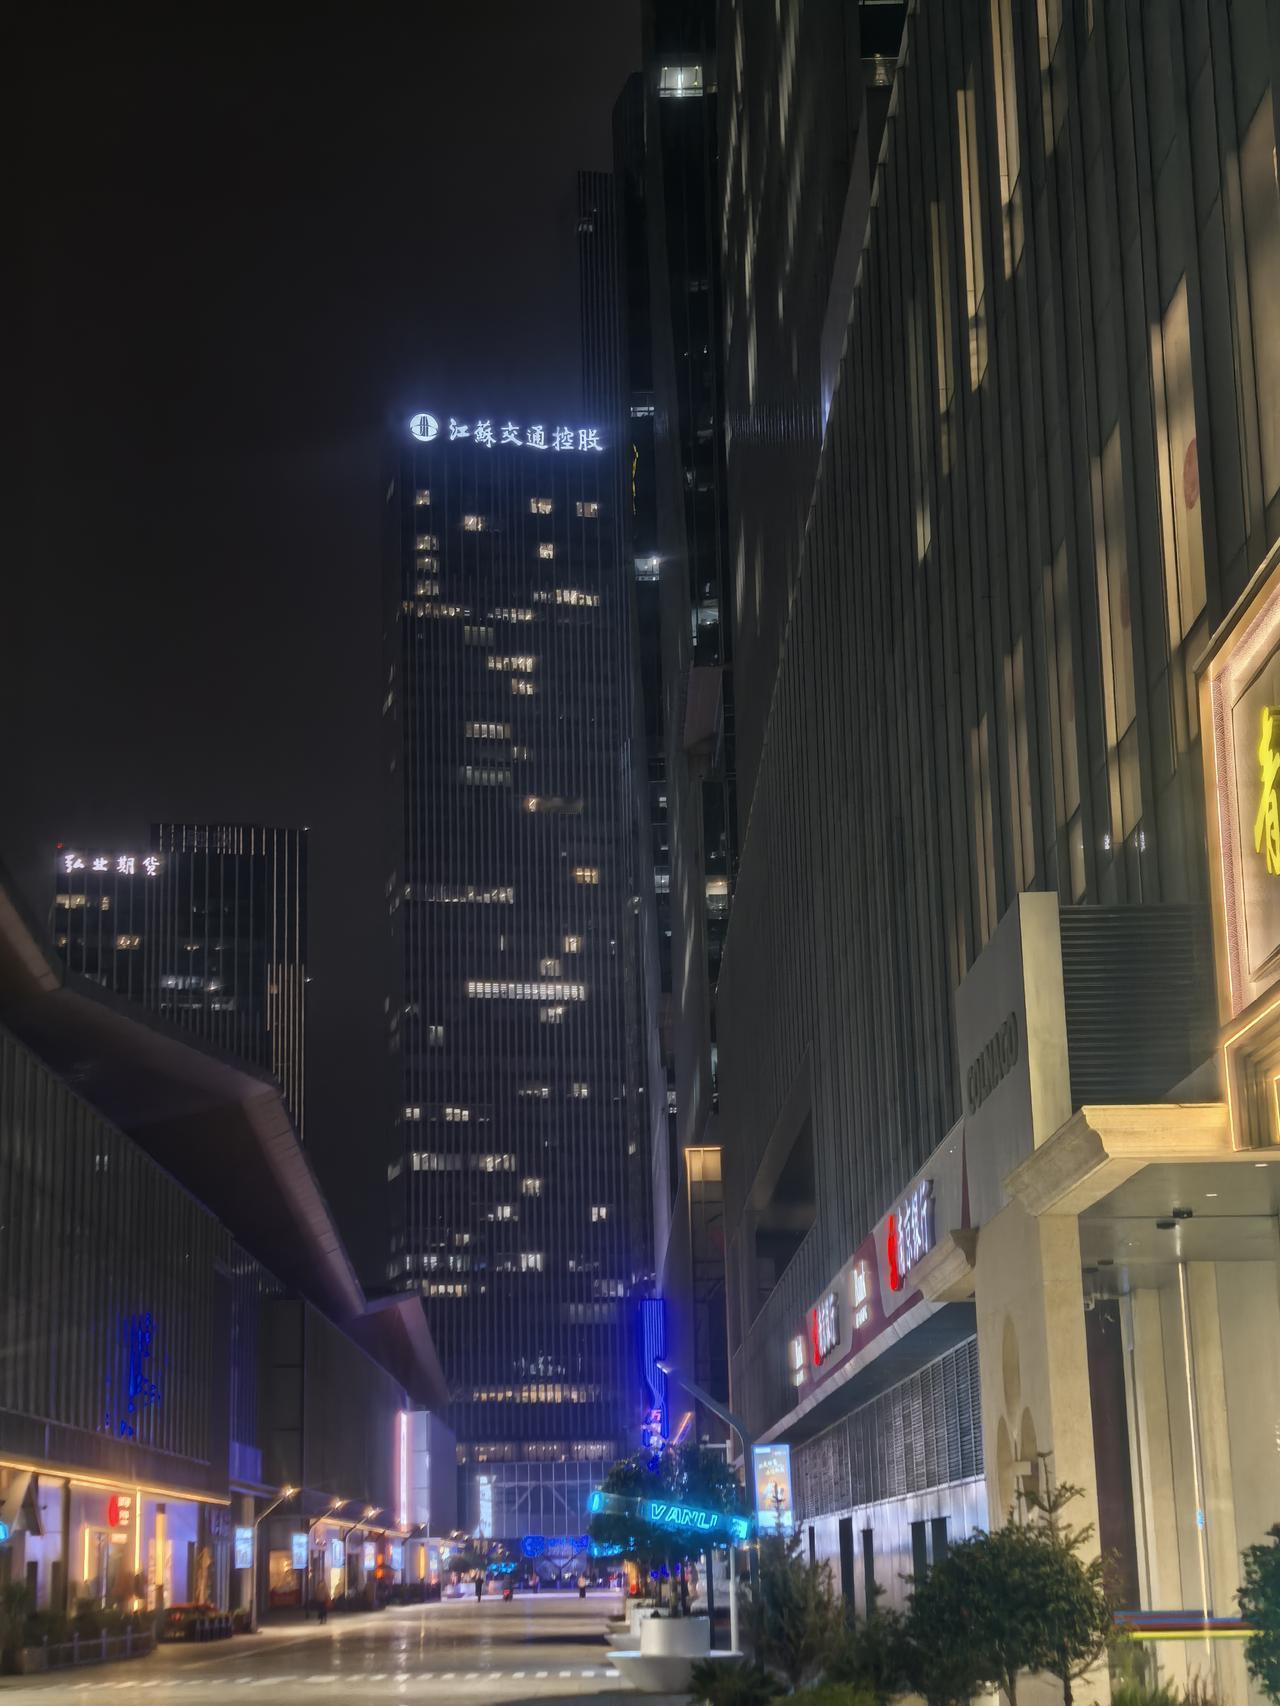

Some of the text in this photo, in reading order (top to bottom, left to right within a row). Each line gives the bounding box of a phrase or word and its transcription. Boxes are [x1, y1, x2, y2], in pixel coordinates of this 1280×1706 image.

[65, 855, 160, 876] 弘业期货
[651, 1503, 718, 1530] VANLI
